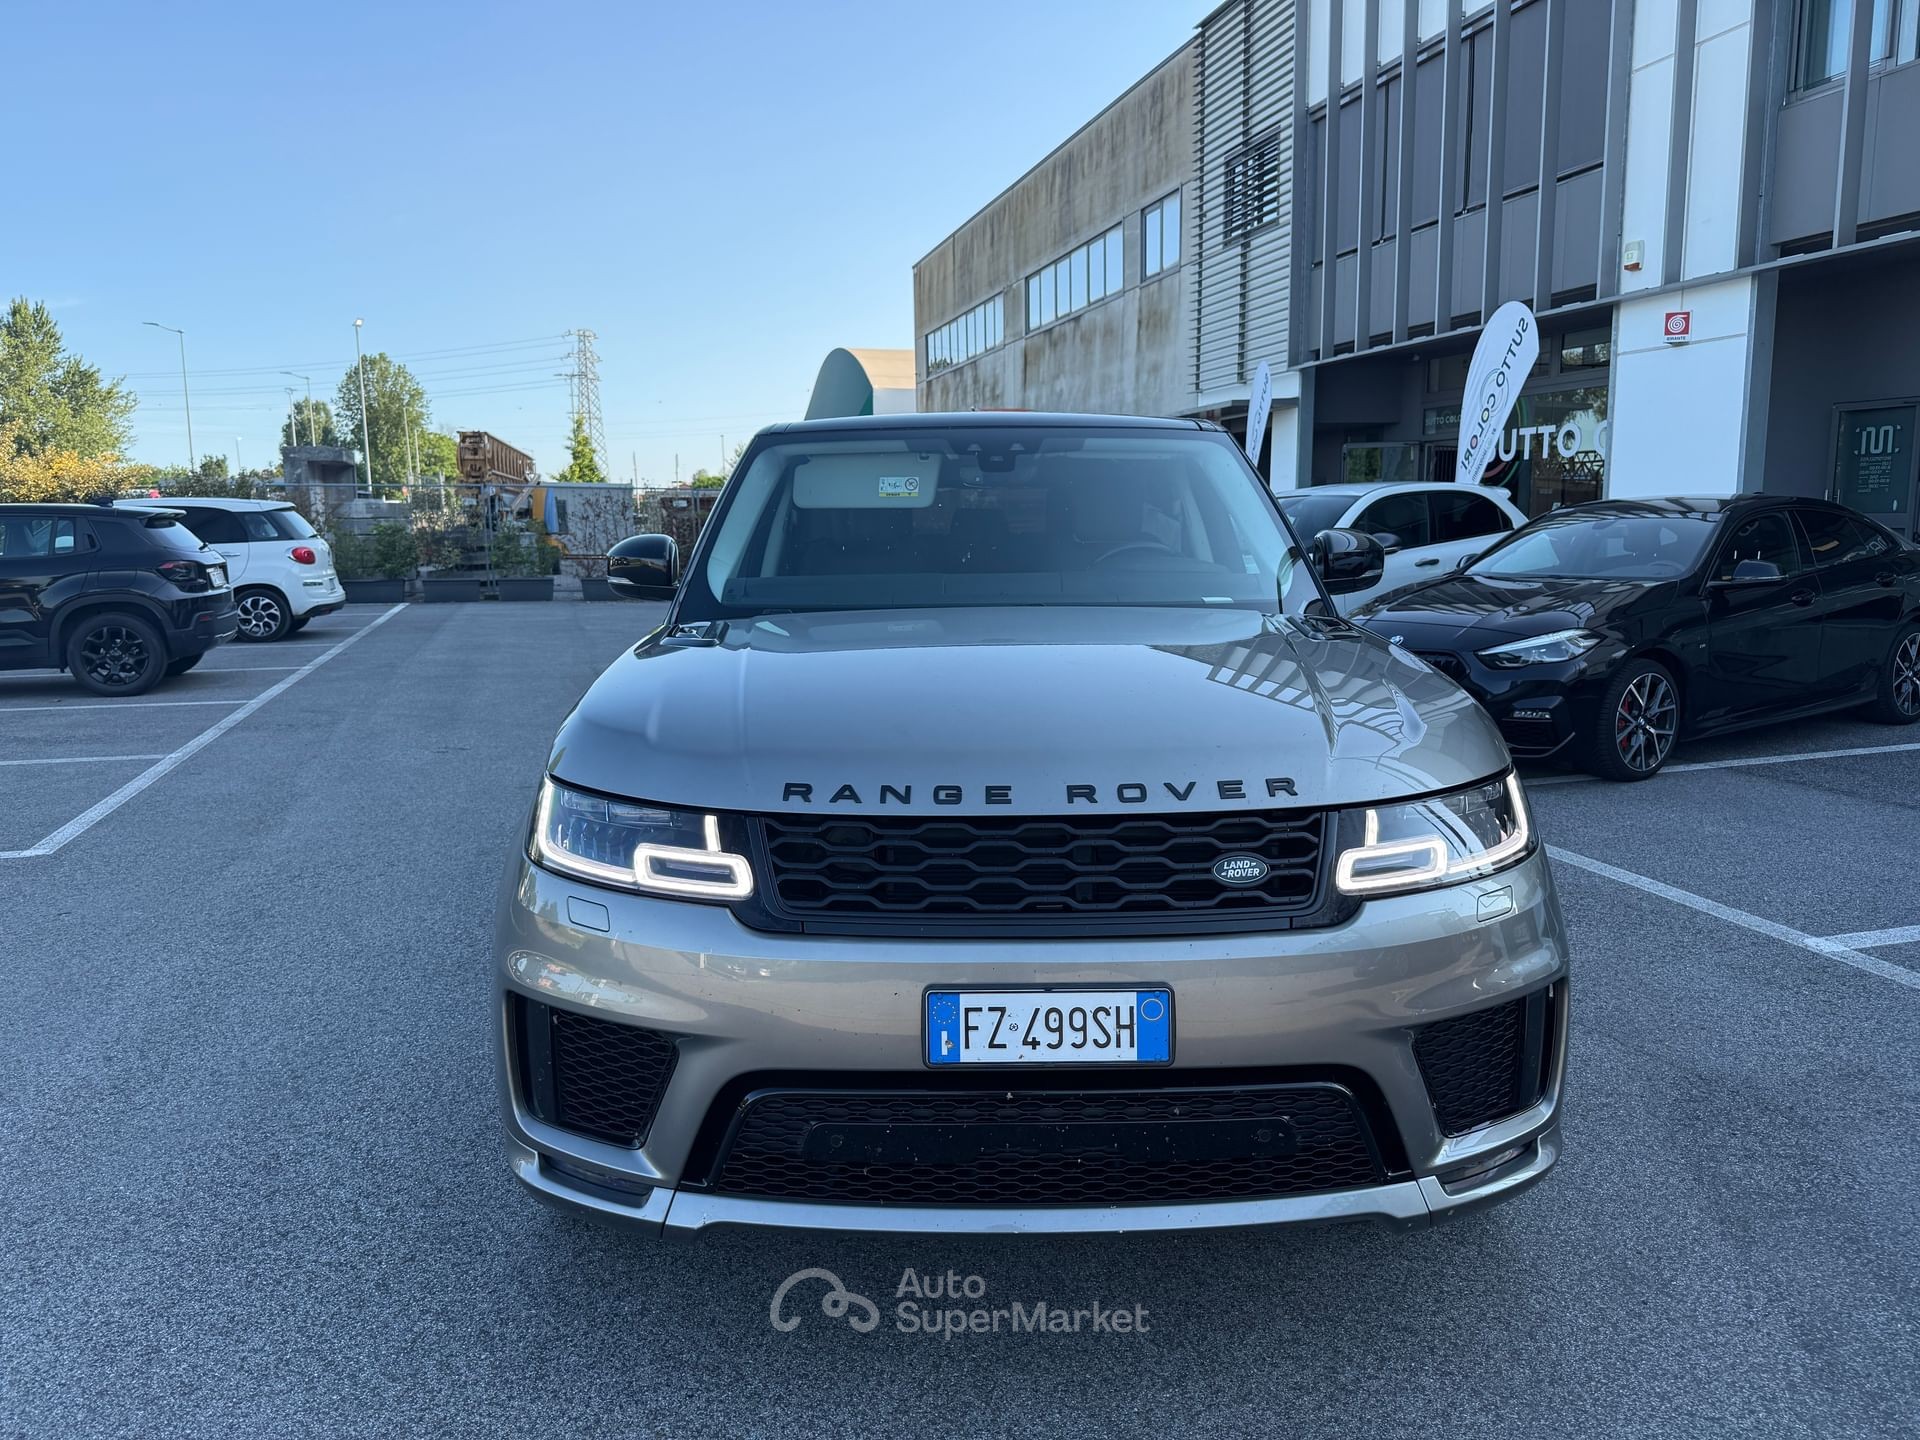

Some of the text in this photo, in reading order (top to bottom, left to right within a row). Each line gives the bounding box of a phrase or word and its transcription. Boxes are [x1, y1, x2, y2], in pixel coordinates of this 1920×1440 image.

[782, 777, 1298, 805] RANGE ROVER
[1223, 860, 1251, 870] LAND
[1227, 868, 1260, 878] ROVER
